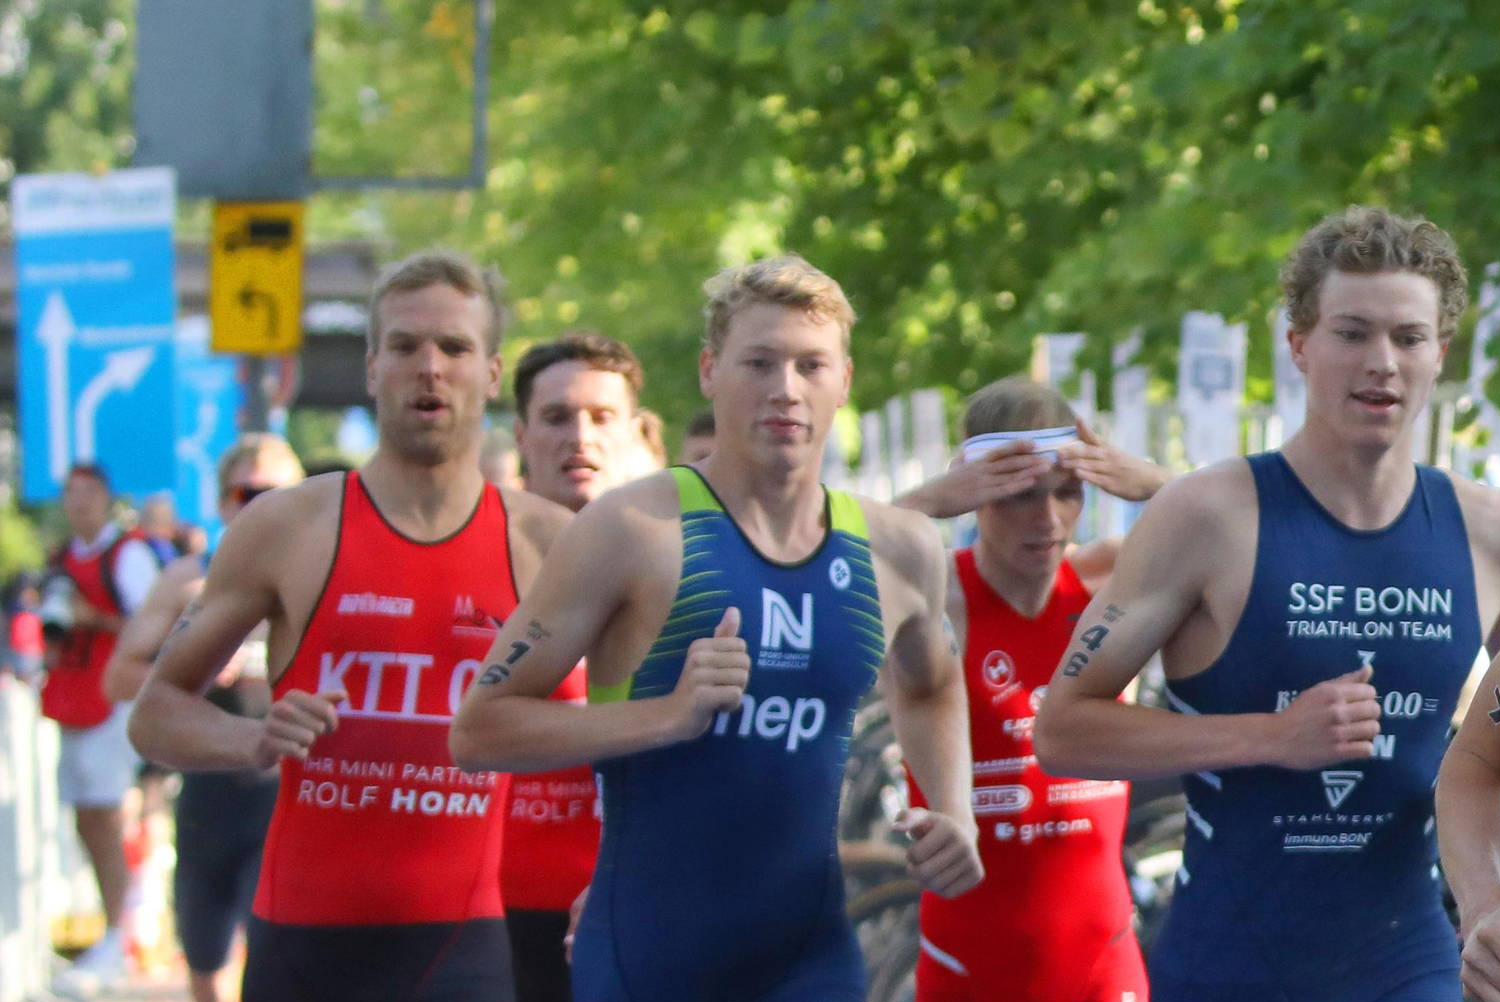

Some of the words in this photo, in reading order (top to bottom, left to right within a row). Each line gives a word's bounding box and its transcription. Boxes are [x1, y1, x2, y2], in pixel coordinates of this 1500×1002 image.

[1288, 582, 1346, 614] SSF
[1354, 585, 1452, 616] BONN
[1286, 619, 1394, 639] TRIATHLON
[1400, 621, 1452, 640] TEAM
[316, 651, 434, 718] KTT
[340, 759, 394, 777] MINI
[297, 780, 380, 808] ROLF
[390, 788, 491, 818] HORN
[1020, 818, 1093, 843] gicom
